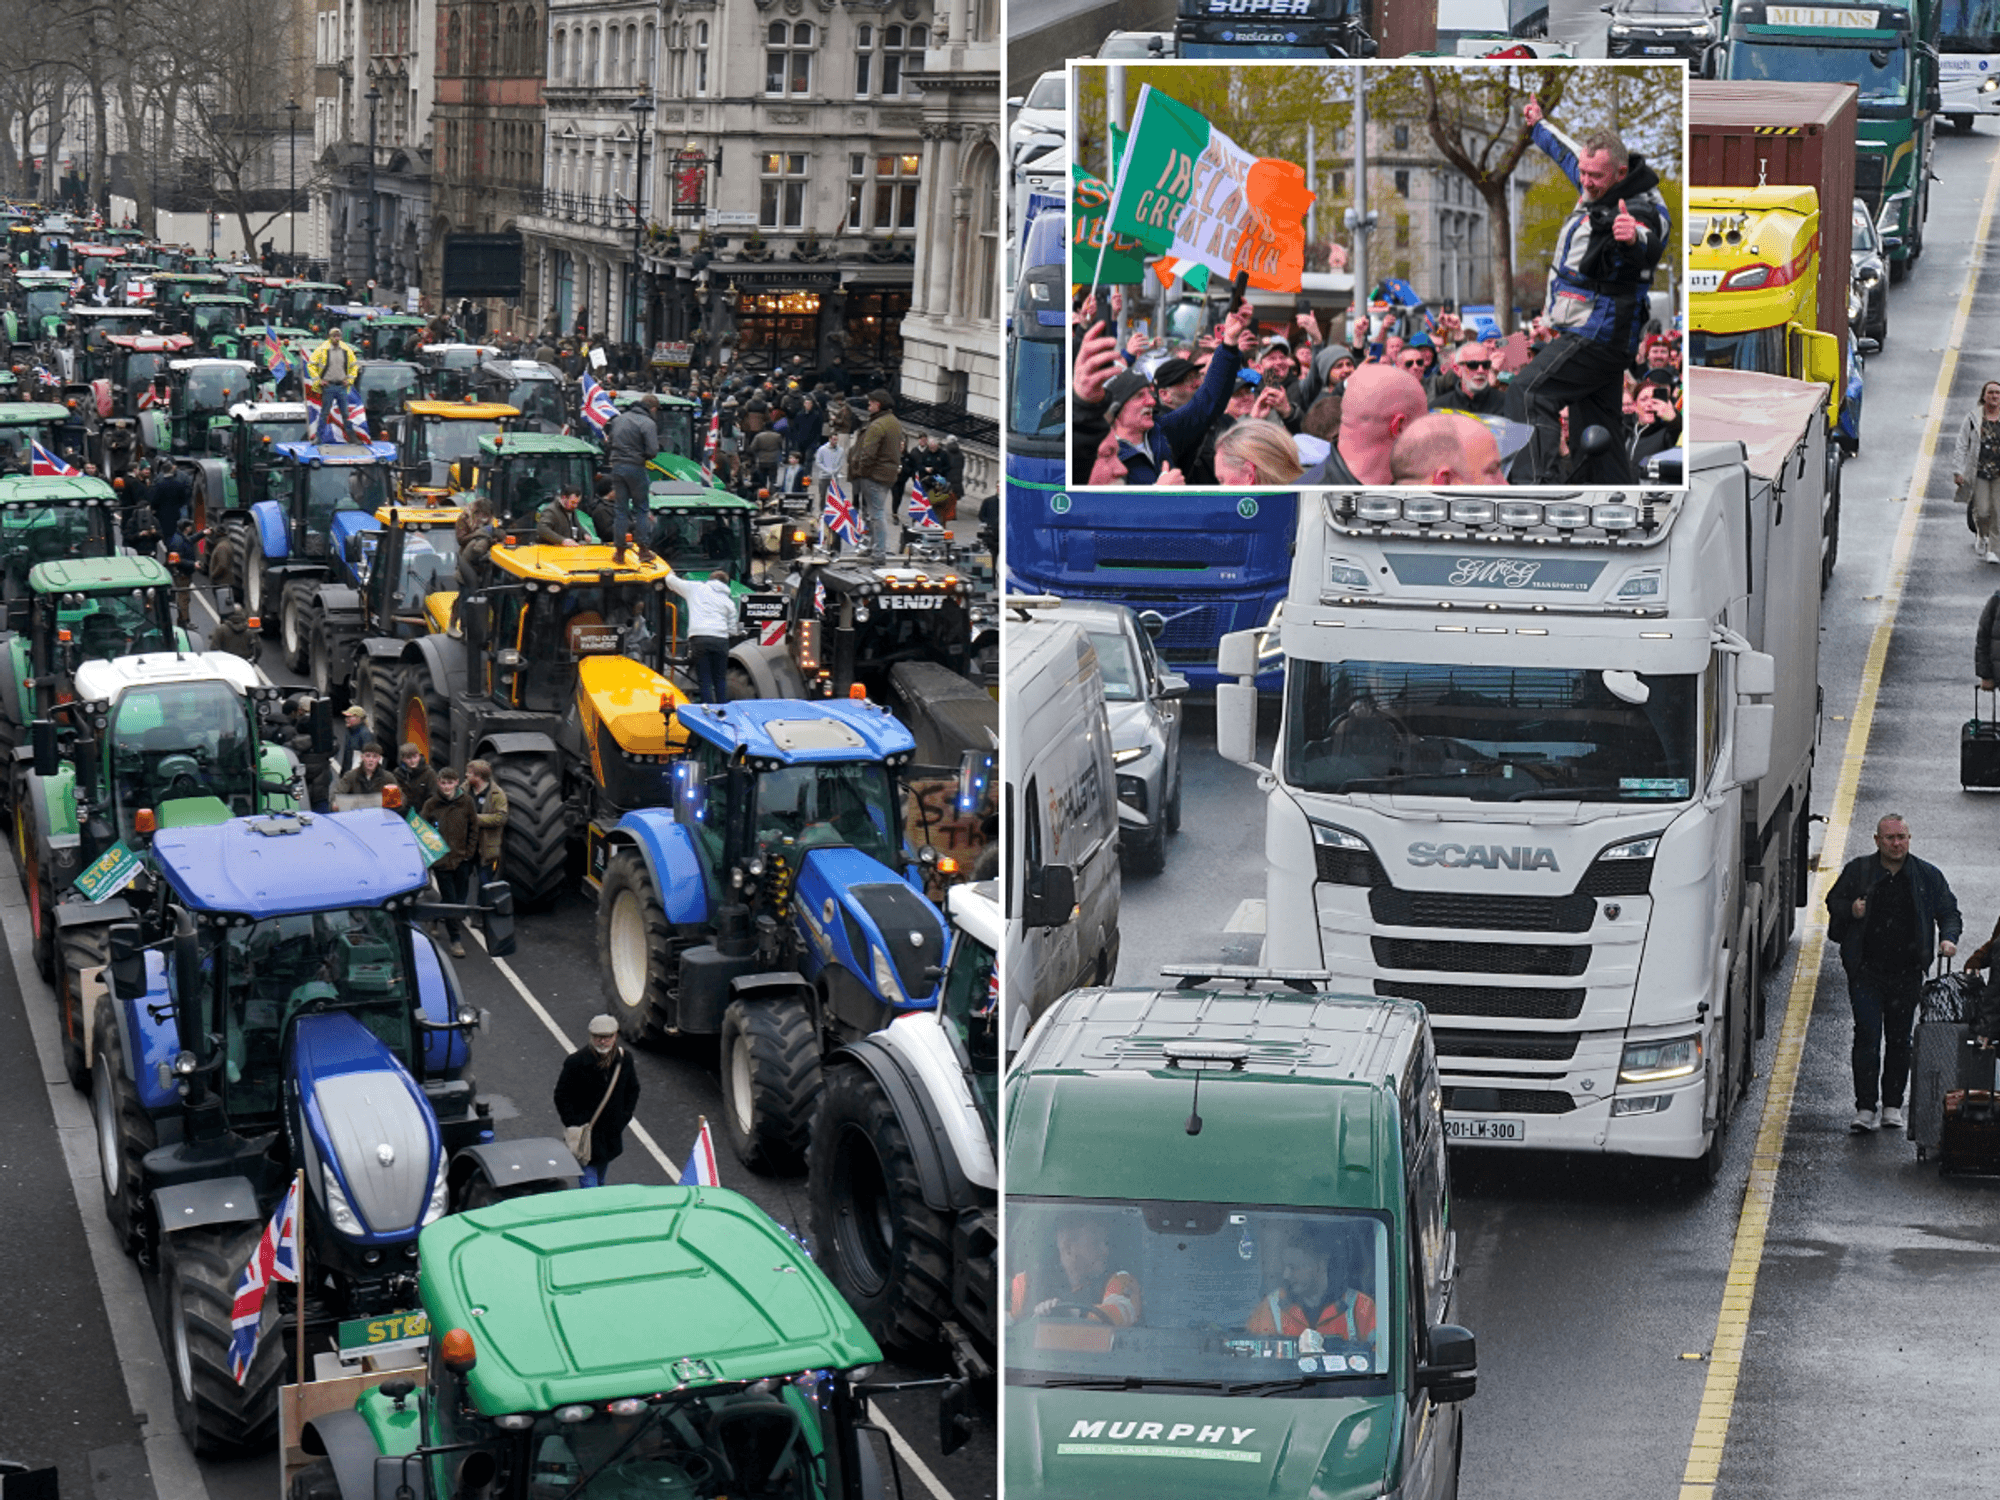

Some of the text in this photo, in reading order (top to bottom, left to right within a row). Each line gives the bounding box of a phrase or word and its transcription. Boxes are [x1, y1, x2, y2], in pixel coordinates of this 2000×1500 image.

[1208, 0, 1309, 14] SUPER
[1772, 9, 1873, 26] MULLINS
[1155, 148, 1277, 243] IRELAND
[1135, 189, 1281, 276] GREAT AGAIN
[1532, 581, 1575, 589] TRANSPORT
[878, 595, 948, 610] FENDT
[1407, 841, 1561, 873] SCANIA
[1445, 1122, 1515, 1138] 201-LM-300
[367, 1314, 432, 1343] STO
[1068, 1420, 1256, 1445] MURPHY
